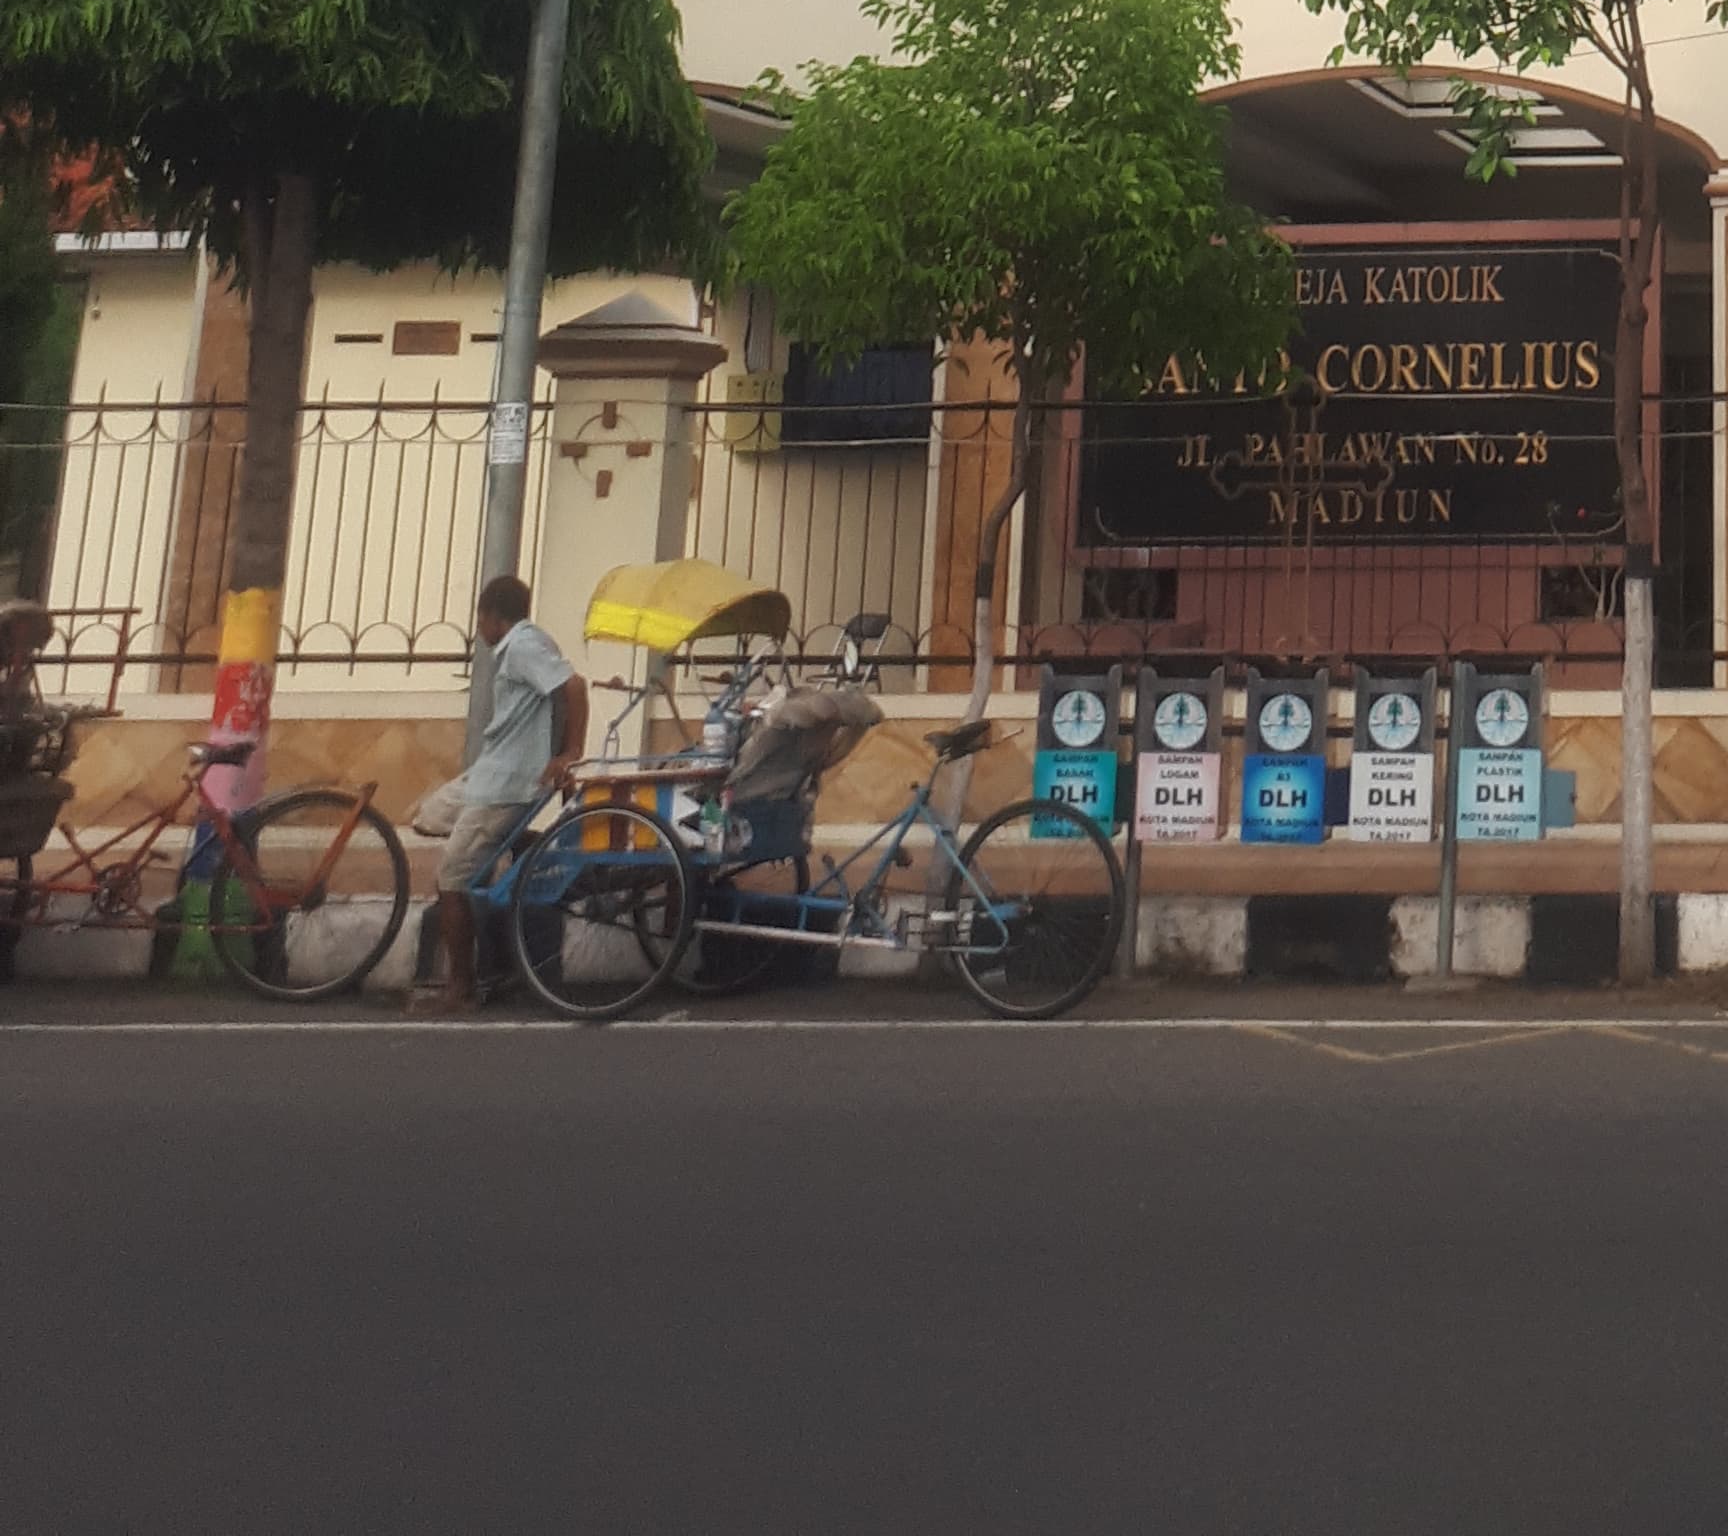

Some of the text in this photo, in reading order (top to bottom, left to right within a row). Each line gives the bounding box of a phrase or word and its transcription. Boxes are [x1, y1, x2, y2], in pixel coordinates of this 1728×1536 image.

[1362, 265, 1505, 304] KATOLIK
[1315, 340, 1600, 393] CORNELIUS
[1244, 431, 1436, 465] PAHLAWAN
[1455, 431, 1504, 464] No.
[1514, 430, 1549, 465] 28
[1267, 488, 1453, 525] MADIUN
[1371, 756, 1416, 766] SAMPAH
[1478, 752, 1524, 762] SAMPAH
[1049, 784, 1099, 804] DLH
[1155, 787, 1203, 806] DLH
[1259, 789, 1308, 808] DLH
[1368, 788, 1416, 807] DLH
[1476, 784, 1525, 803] DLH
[1353, 816, 1428, 827] KOTA MADIUN
